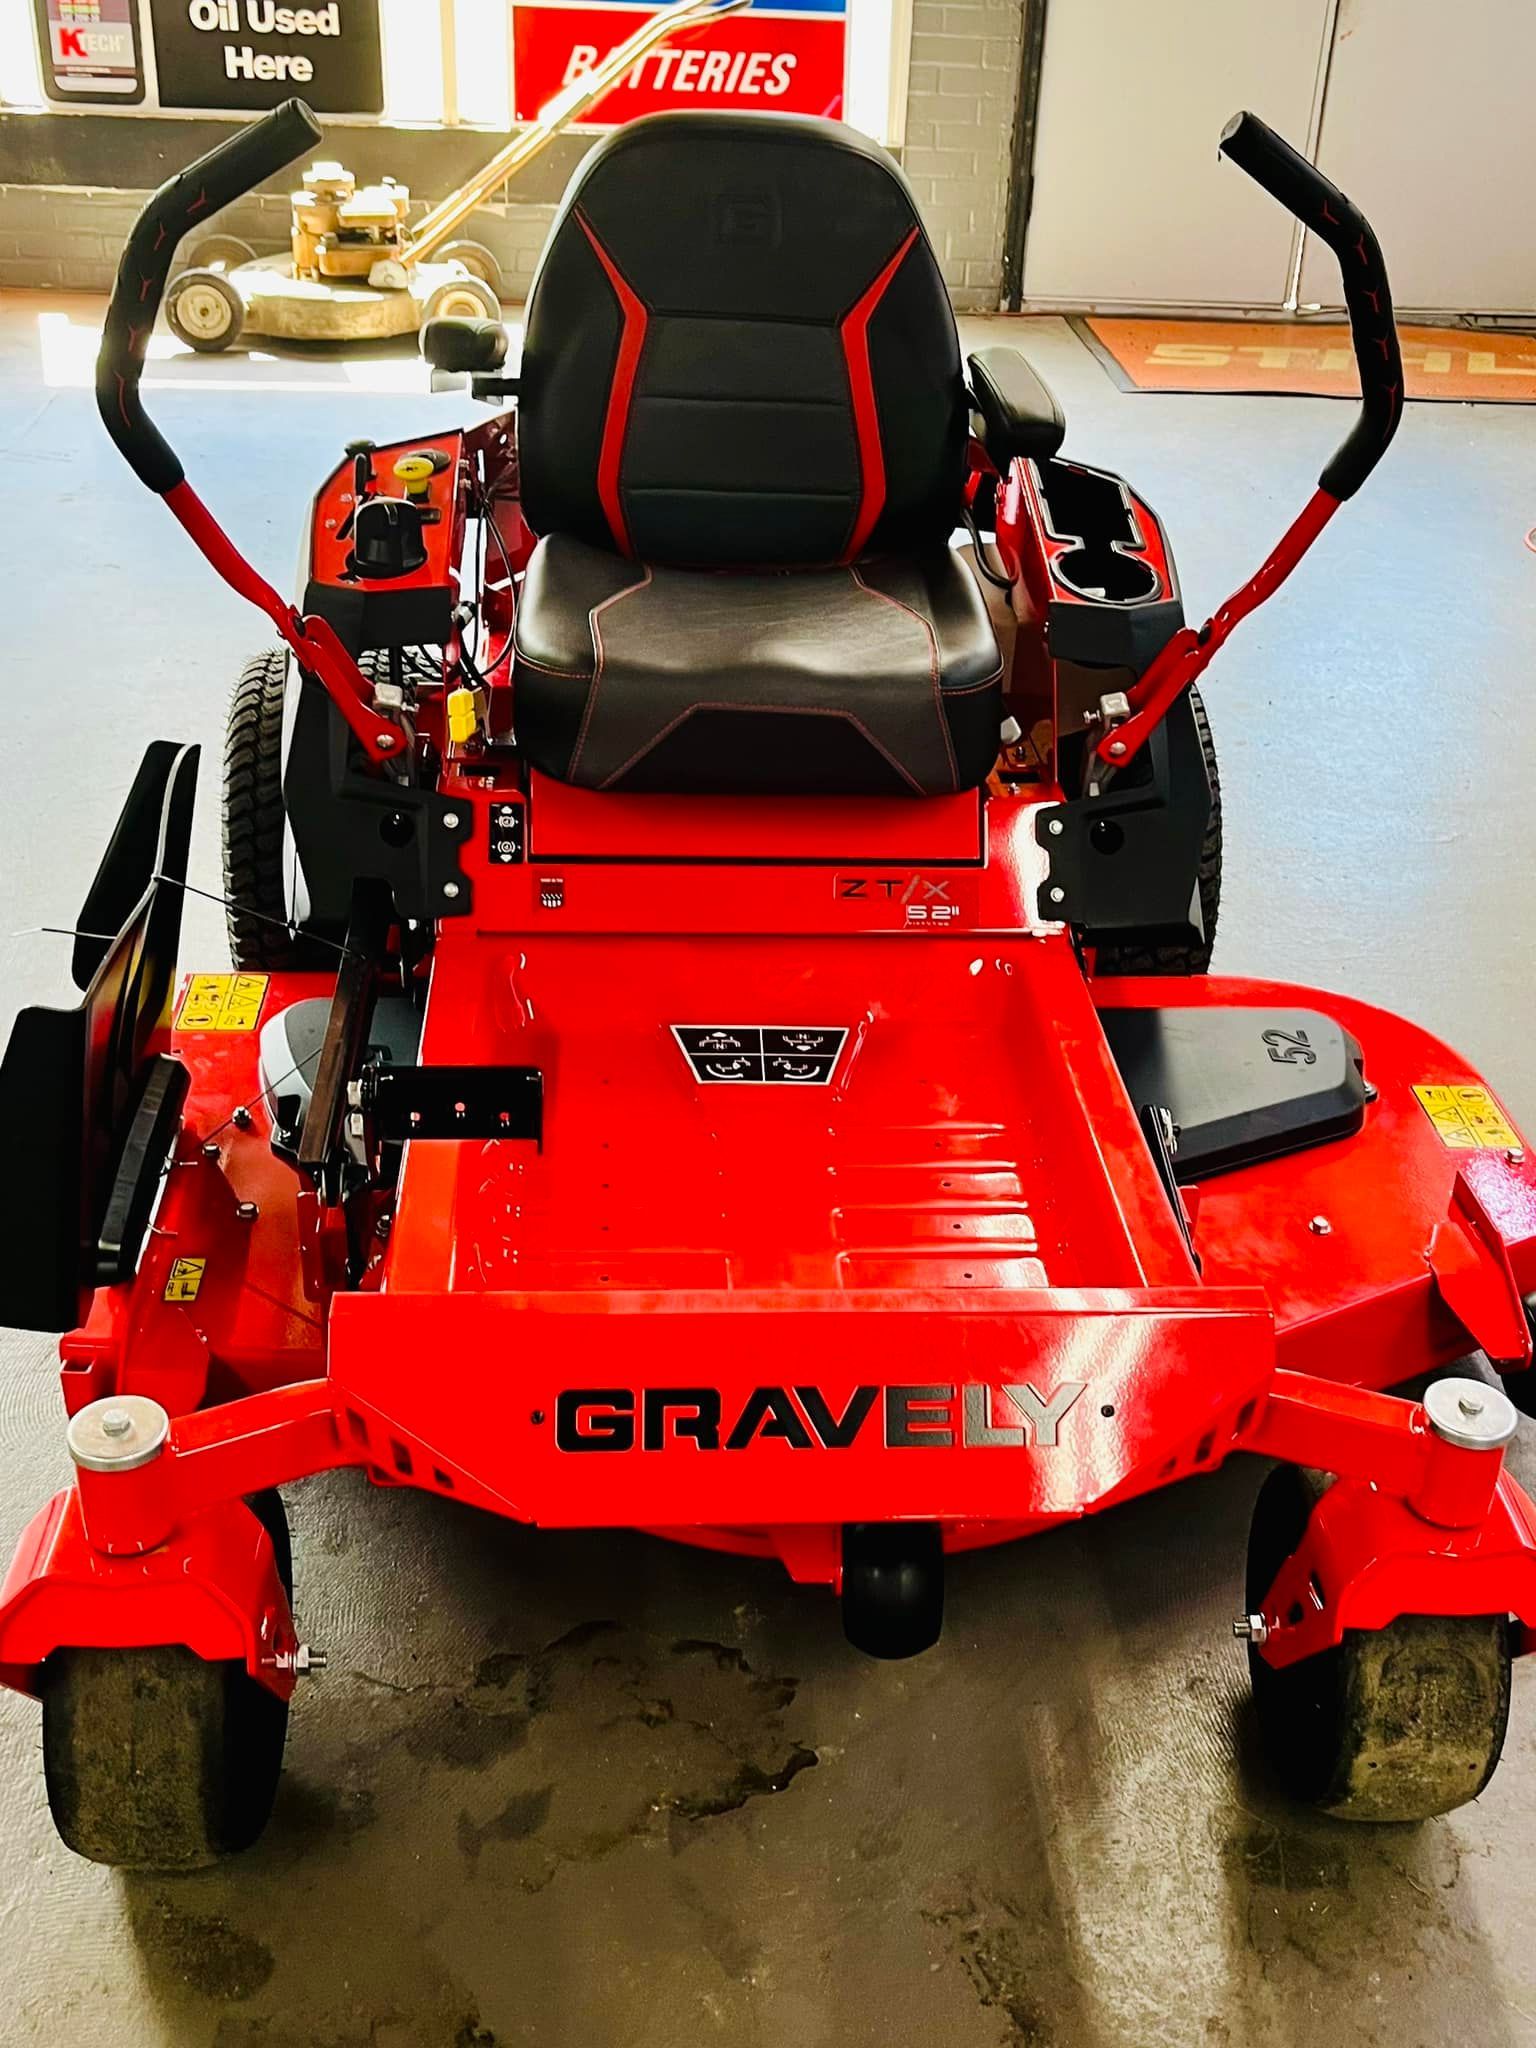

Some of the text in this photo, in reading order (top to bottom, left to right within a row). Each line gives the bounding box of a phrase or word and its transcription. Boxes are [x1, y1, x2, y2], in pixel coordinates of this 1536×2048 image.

[189, 0, 340, 36] Oil Used
[223, 45, 314, 82] Here
[1261, 1029, 1316, 1065] 52
[555, 1383, 1088, 1452] GRAVELY
